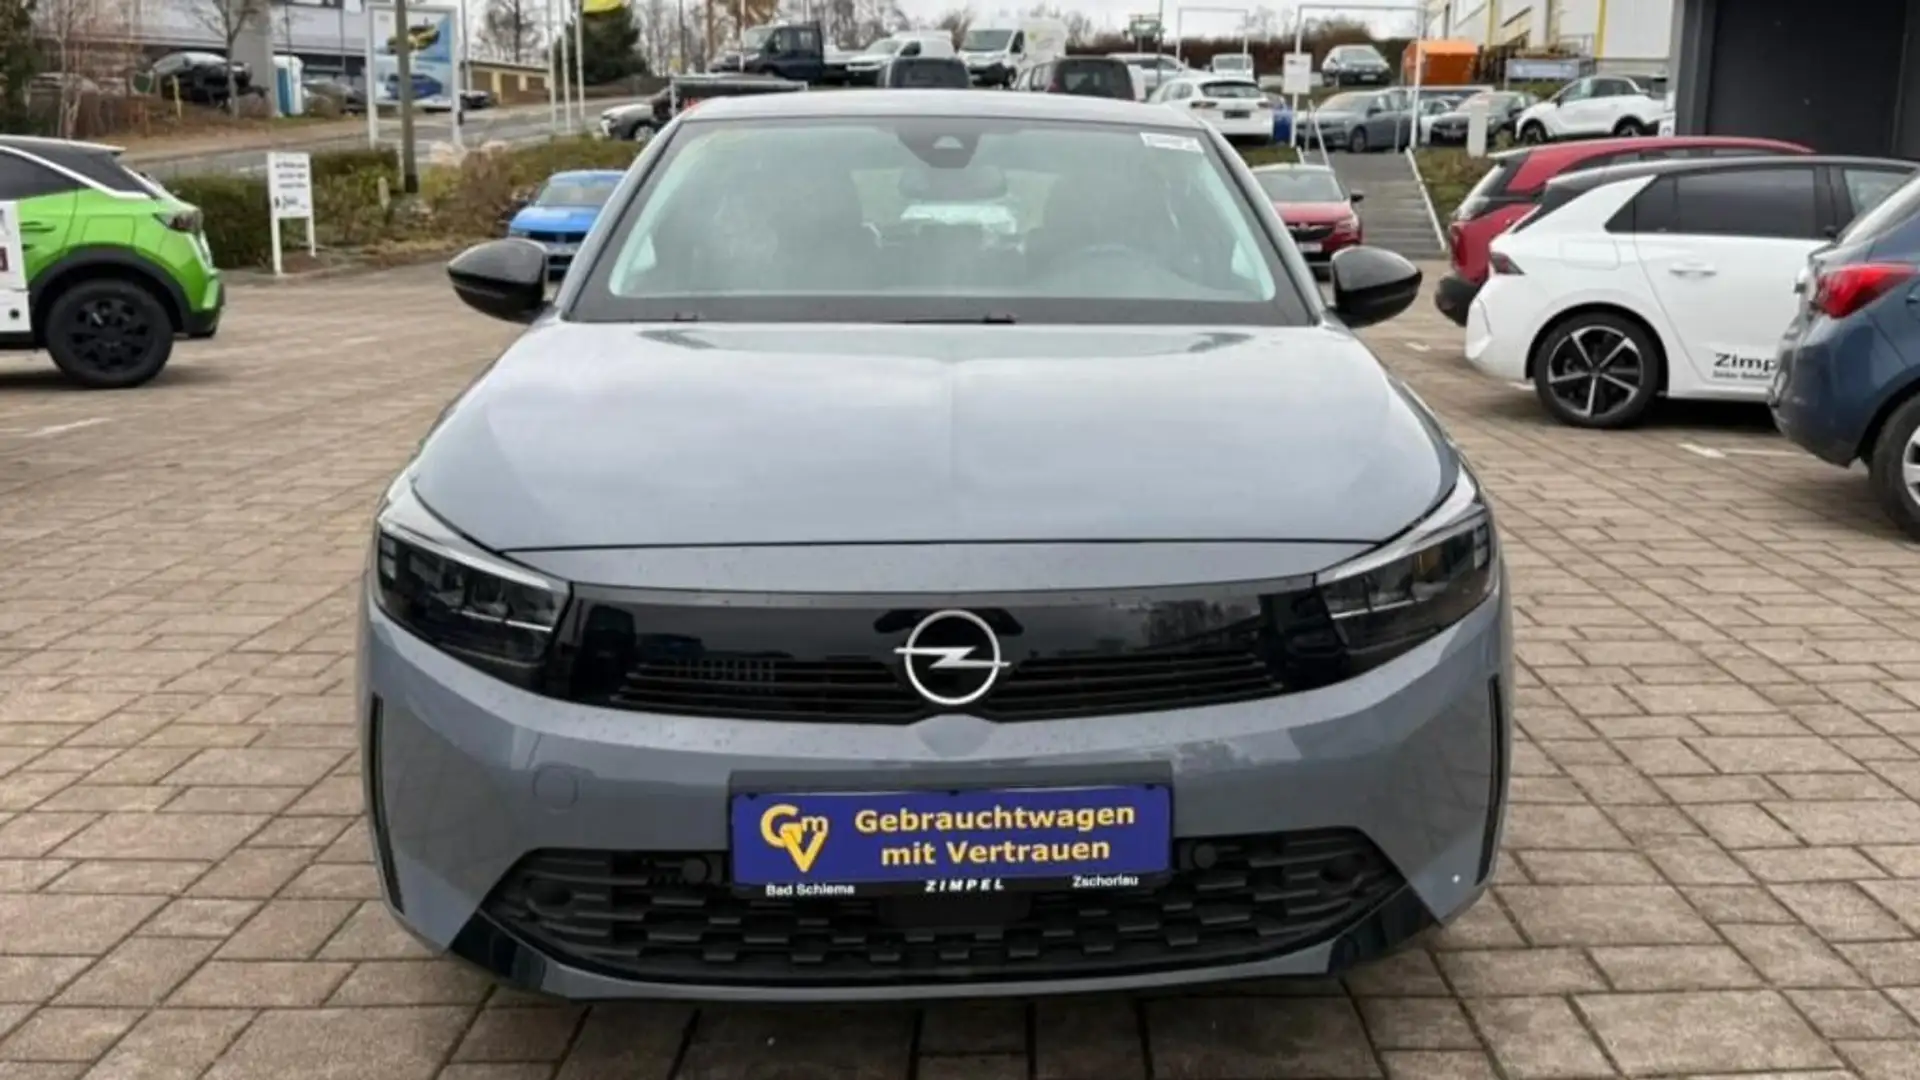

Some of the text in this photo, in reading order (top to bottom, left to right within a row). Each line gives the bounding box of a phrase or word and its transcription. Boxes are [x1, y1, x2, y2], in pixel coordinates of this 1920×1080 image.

[855, 805, 1135, 833] Gebrauchtwagen
[882, 840, 1110, 866] mit Vertrauen
[766, 884, 793, 896] Bad
[924, 878, 1004, 892] ZIMPEL
